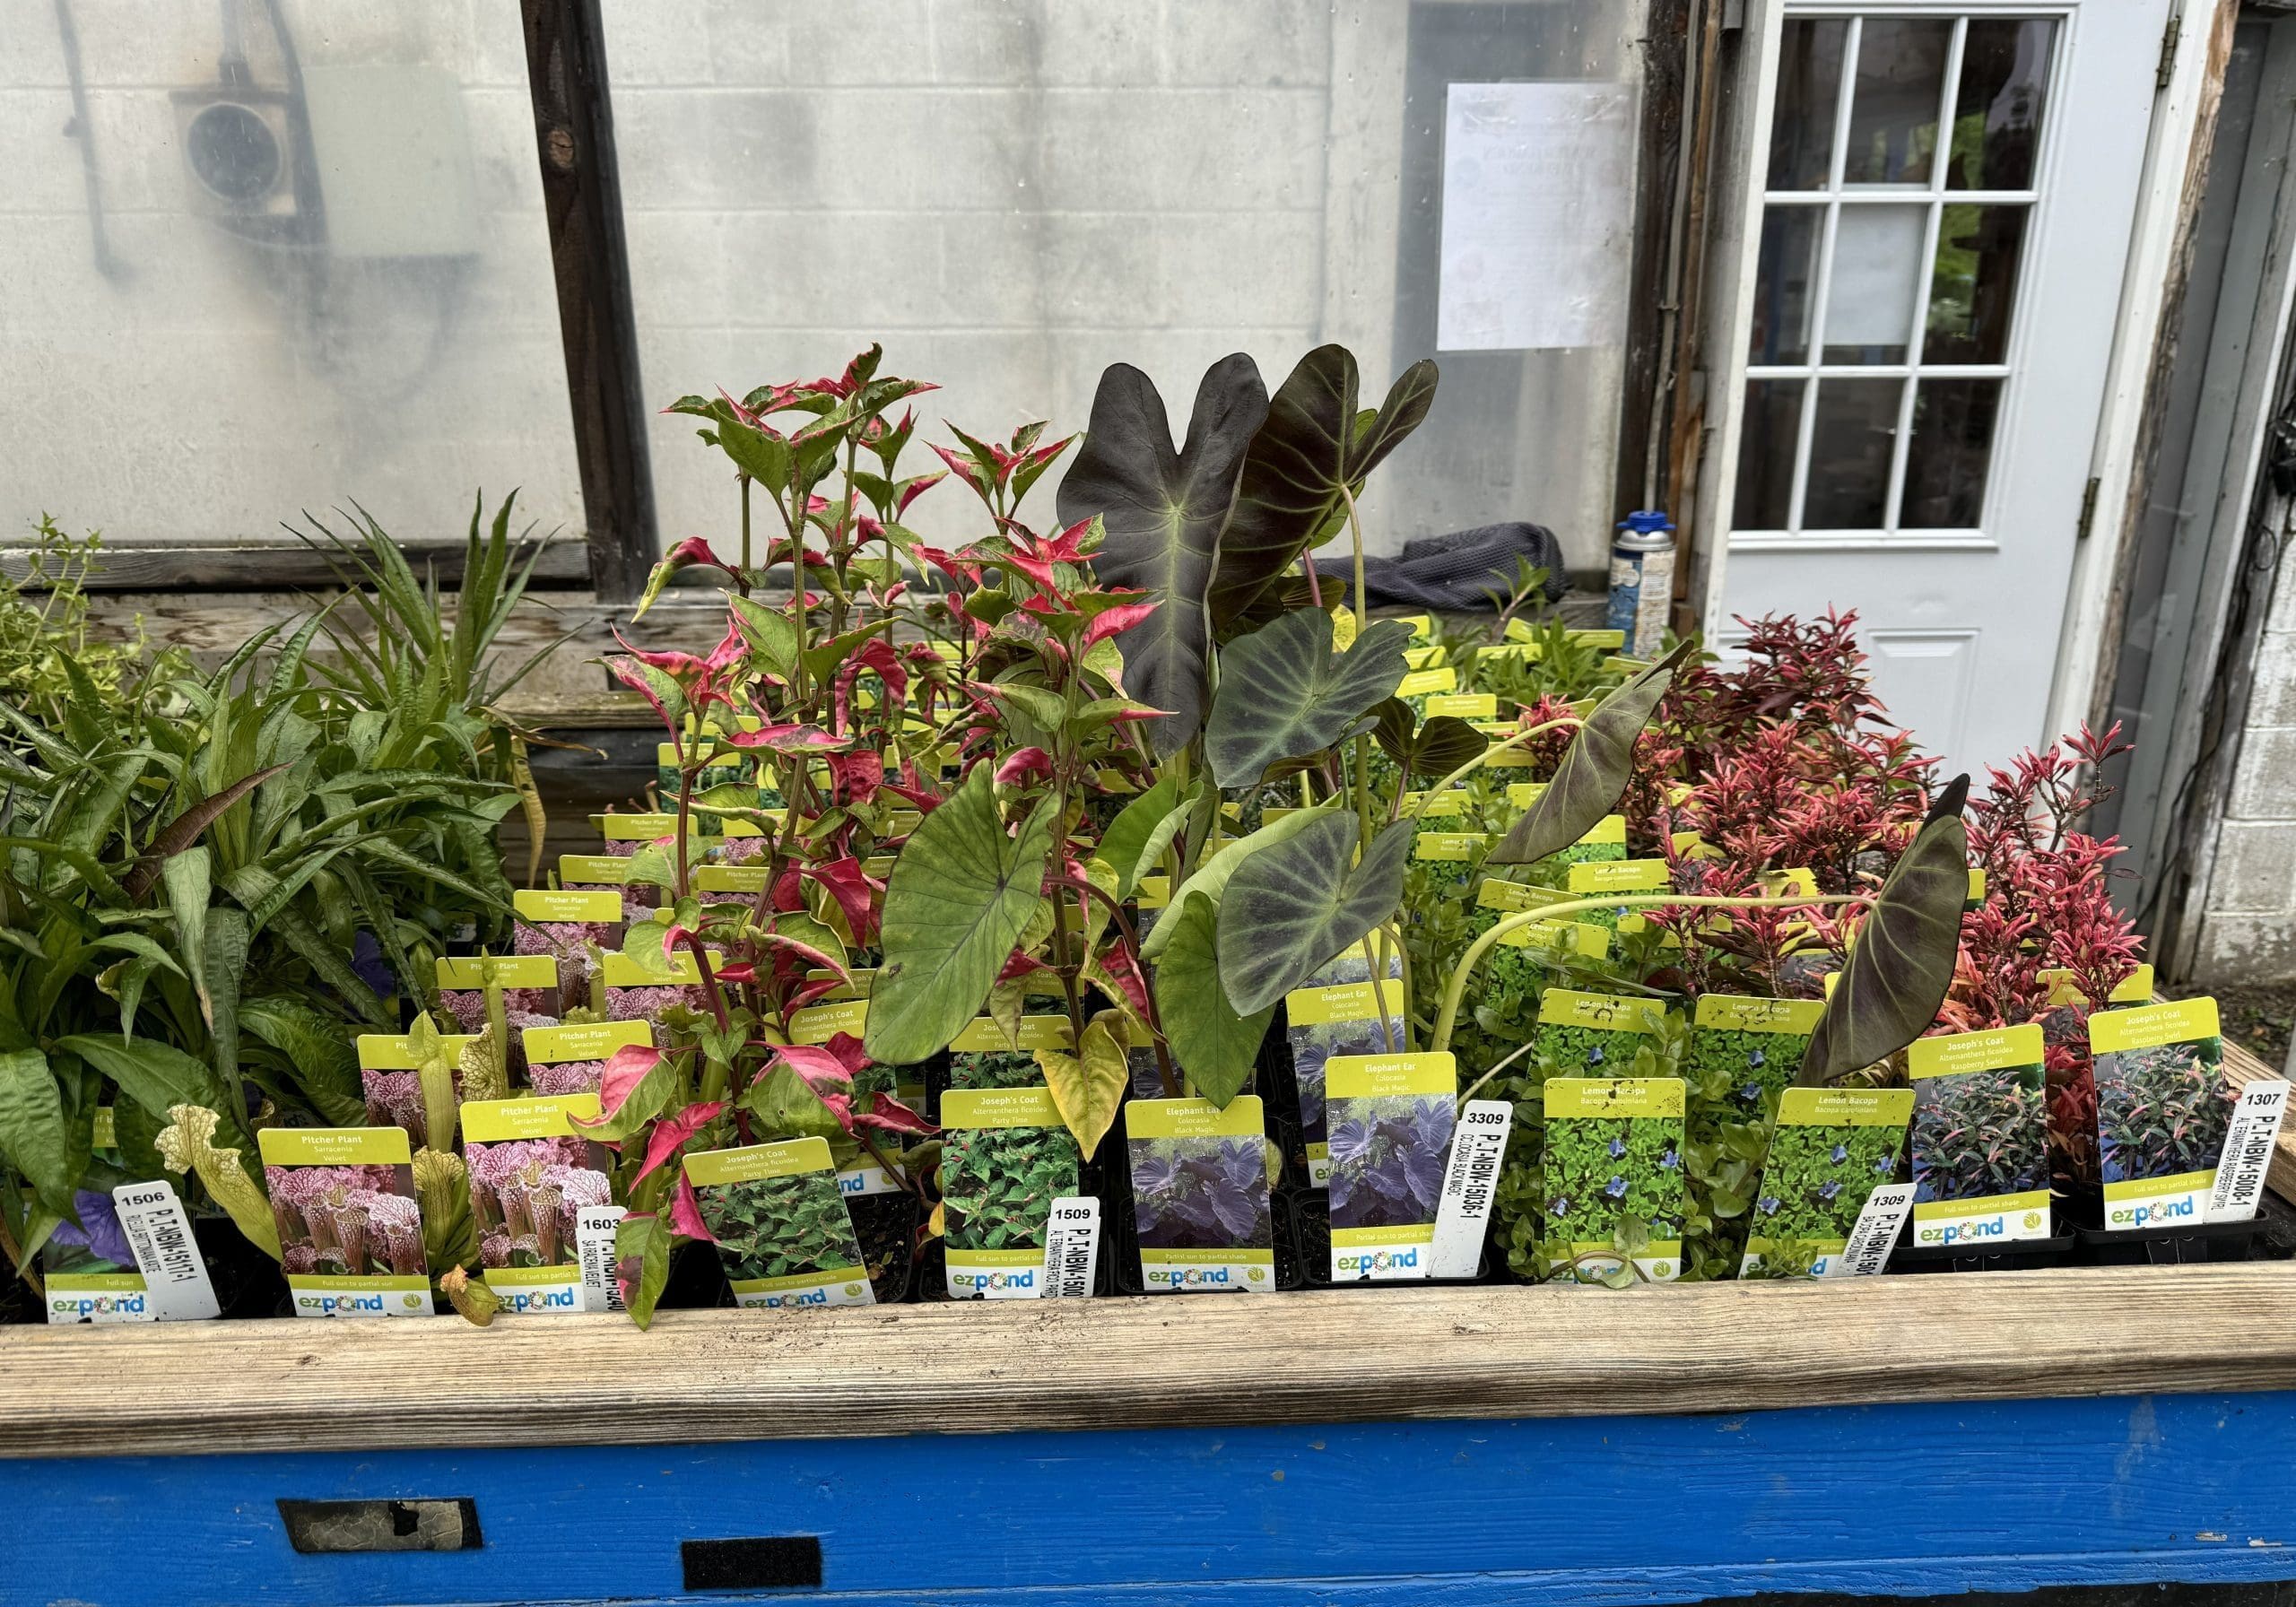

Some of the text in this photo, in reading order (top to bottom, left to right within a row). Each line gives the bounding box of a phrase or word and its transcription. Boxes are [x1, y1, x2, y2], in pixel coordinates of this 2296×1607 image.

[1322, 992, 1353, 1001] Elephant
[801, 1010, 854, 1023] Joseph's Coat
[2126, 1011, 2181, 1024] Joseph's Coat
[560, 1030, 612, 1040] Pitcher Plant
[1947, 1037, 2004, 1051] Joseph's Coat
[1365, 1063, 1415, 1073] Elephant Ear
[981, 1096, 1018, 1107] Joseph's
[1819, 1096, 1878, 1106] Lemon Bacopa
[2247, 1094, 2281, 1105] 1307
[501, 1105, 558, 1116] Pitcher Plant
[972, 1108, 1019, 1116] Alternanthera
[1166, 1107, 1205, 1116] Elephant
[1467, 1112, 1504, 1125] 3309
[301, 1136, 334, 1144] Pitcher
[726, 1150, 787, 1164] Joseph's Coat
[2230, 1116, 2276, 1205] PLT-NBW-15008-1
[1460, 1134, 1501, 1220] PLT-NBW-15036-1
[122, 1193, 165, 1206] 1506
[1873, 1194, 1905, 1207] 1309
[1979, 1202, 2000, 1211] partial
[2111, 1195, 2194, 1225] ezpond
[1055, 1209, 1091, 1220] 1509
[583, 1220, 621, 1230] 1603
[1920, 1216, 2004, 1244] ezpond
[147, 1209, 197, 1282] PLT-NBW-15117-1
[1064, 1229, 1091, 1298] PLT-NBW-1500
[1337, 1248, 1417, 1273] ezpond
[953, 1270, 1033, 1291] ezpond
[1148, 1268, 1229, 1286] ezpond
[300, 1295, 383, 1312] ezpond
[744, 1289, 827, 1307] ezpond
[53, 1295, 144, 1316] ezpond
